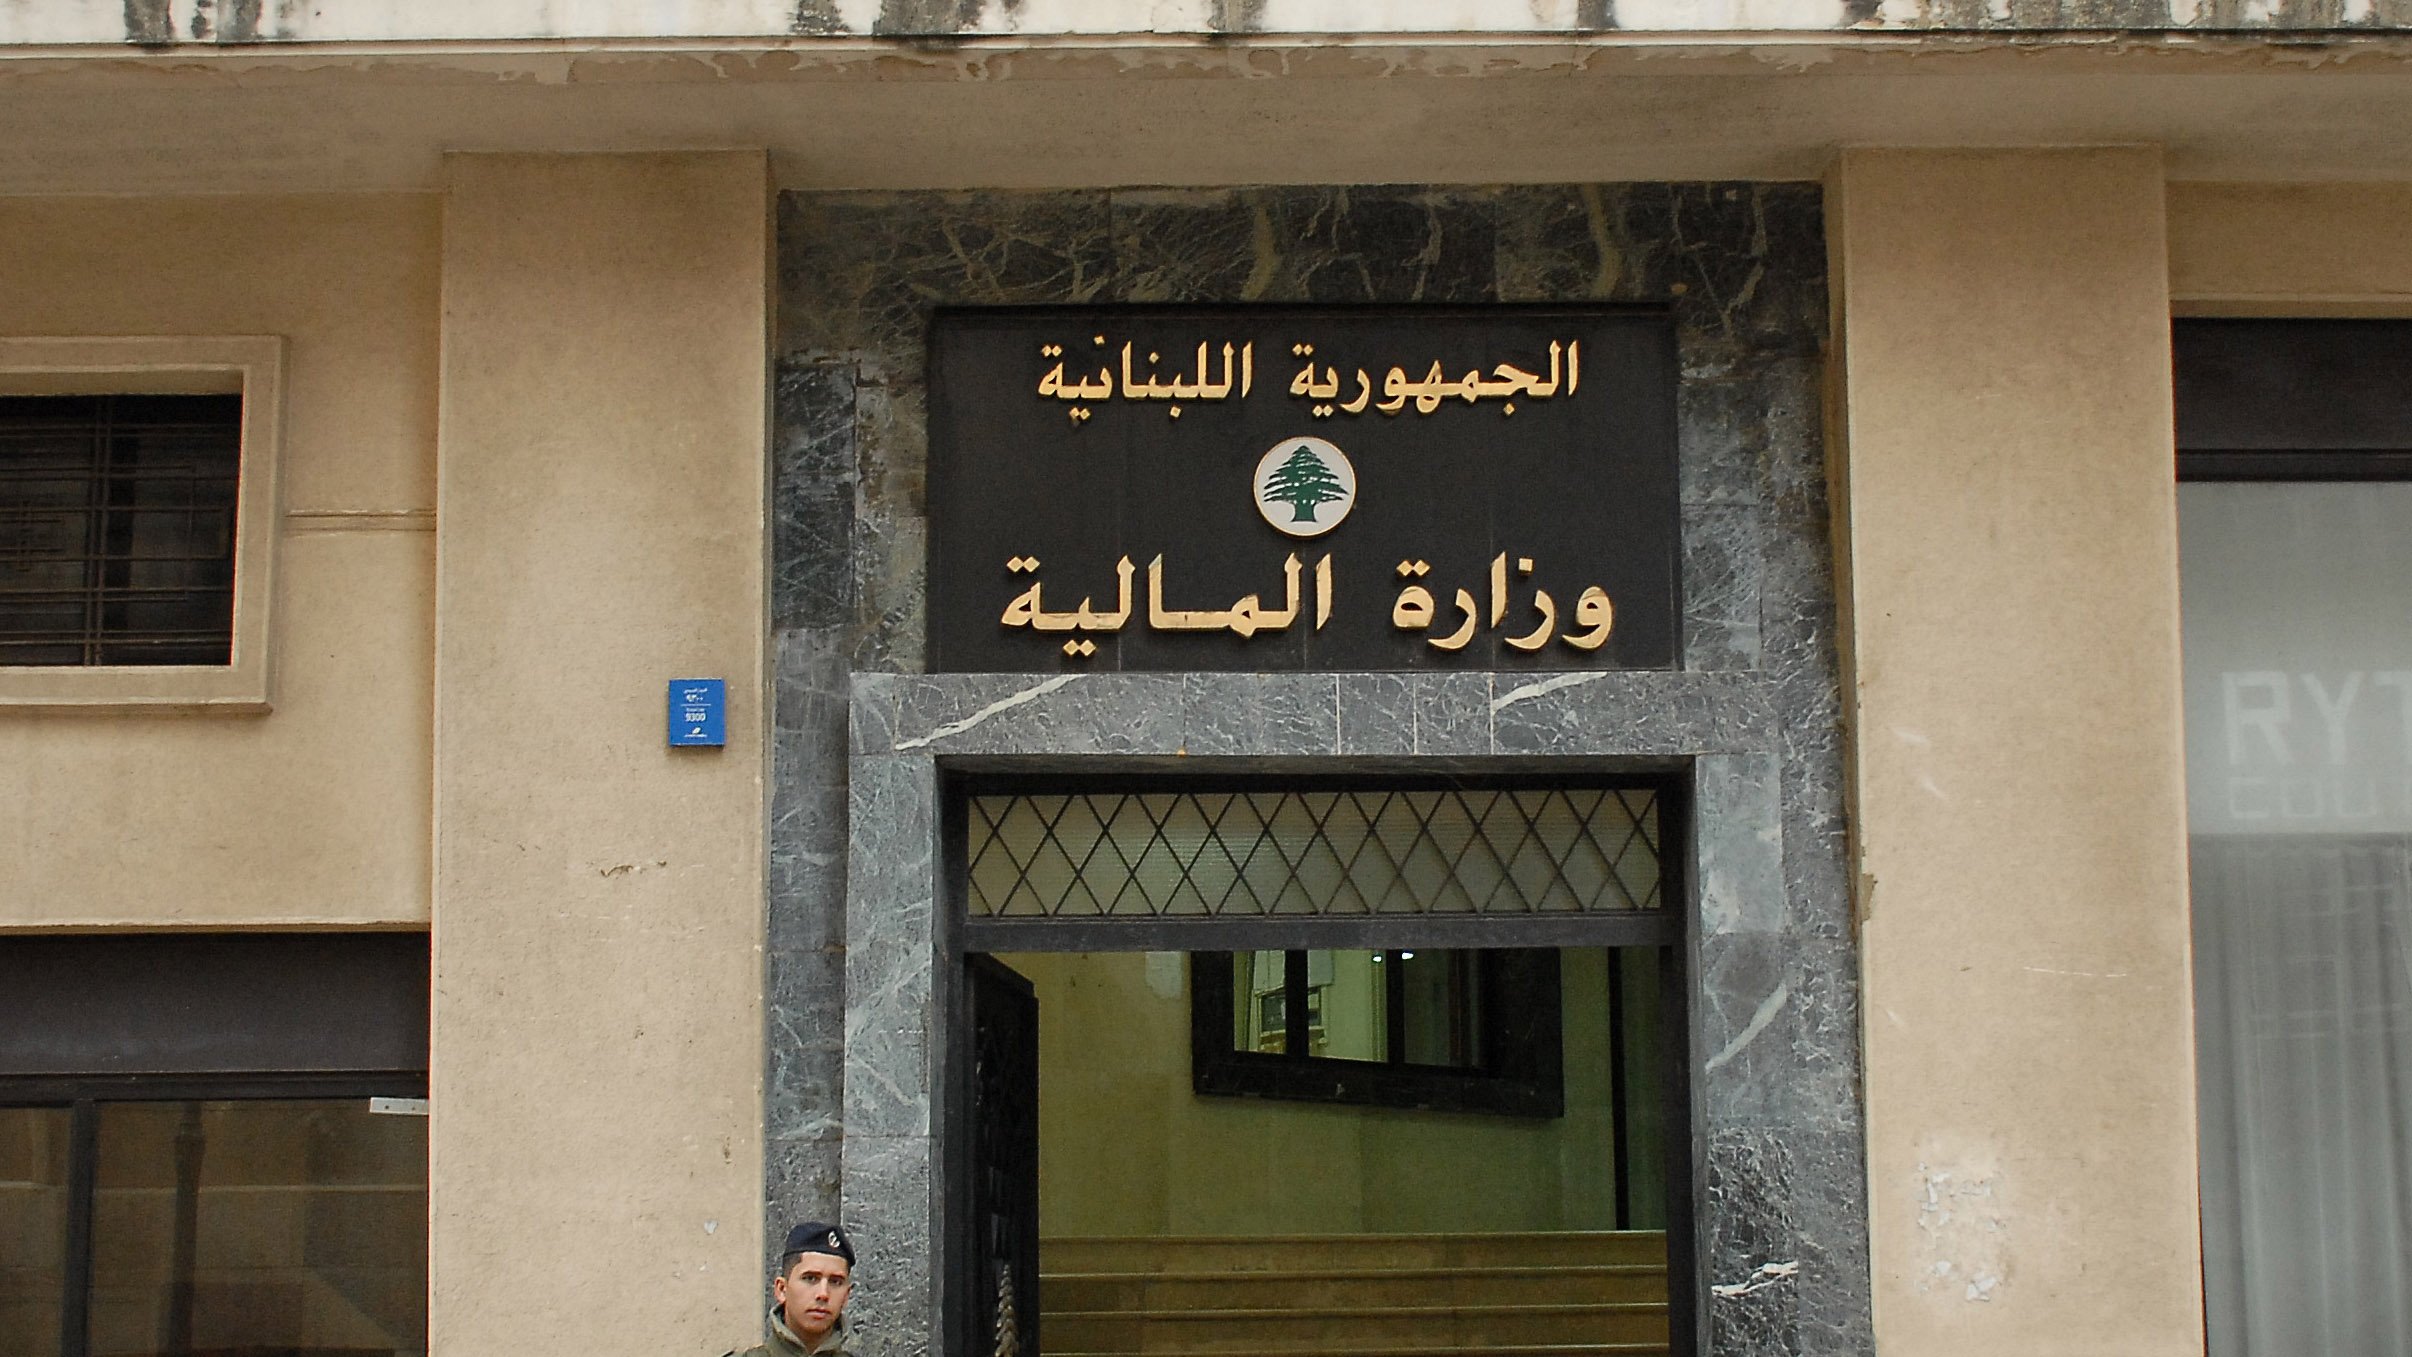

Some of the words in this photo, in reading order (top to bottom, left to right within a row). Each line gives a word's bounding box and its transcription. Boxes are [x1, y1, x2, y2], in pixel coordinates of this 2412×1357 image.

[1038, 336, 1252, 419] اللبنانية
[1290, 340, 1578, 416] الجمهورية
[1001, 553, 1332, 656] المالية
[1393, 552, 1613, 649] وزارة
